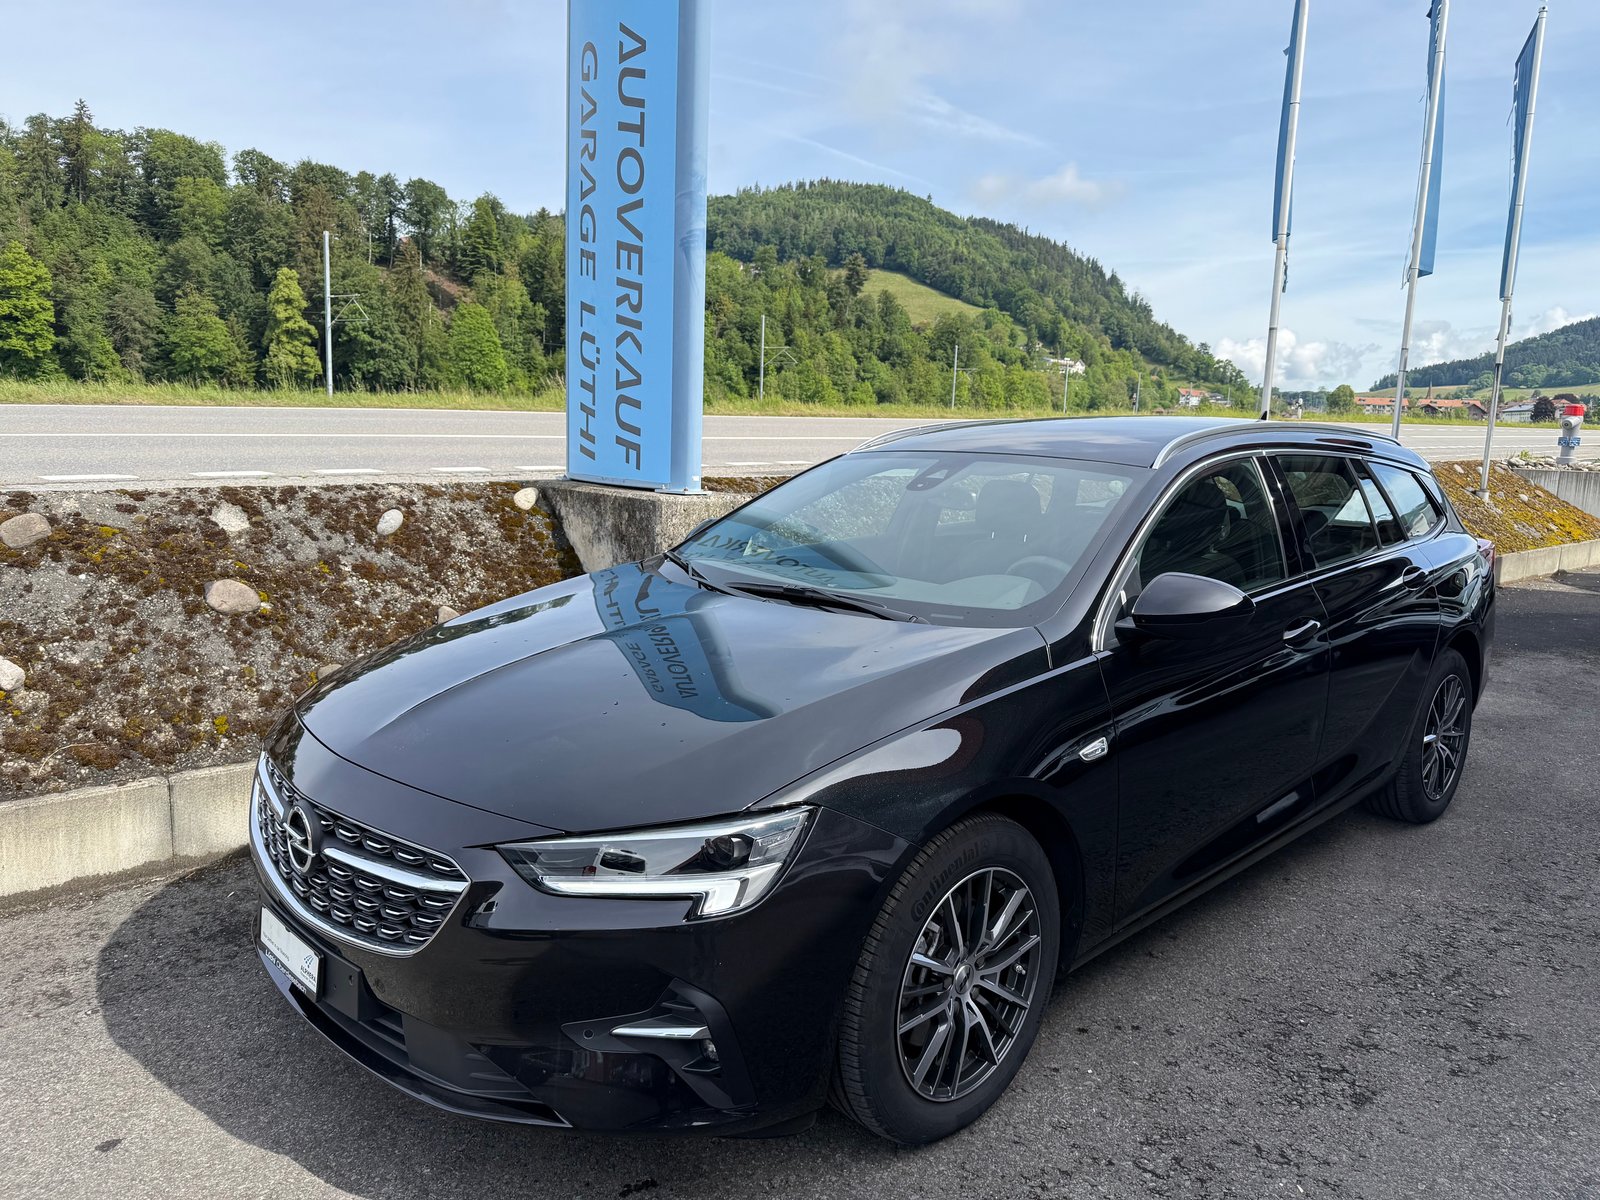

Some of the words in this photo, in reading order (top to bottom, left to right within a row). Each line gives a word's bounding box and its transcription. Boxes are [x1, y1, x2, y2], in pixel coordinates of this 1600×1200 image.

[580, 41, 598, 281] GARAGE
[614, 22, 647, 471] AUTOVERKAUF
[579, 300, 601, 461] LÜTHI
[910, 842, 979, 922] Continental
